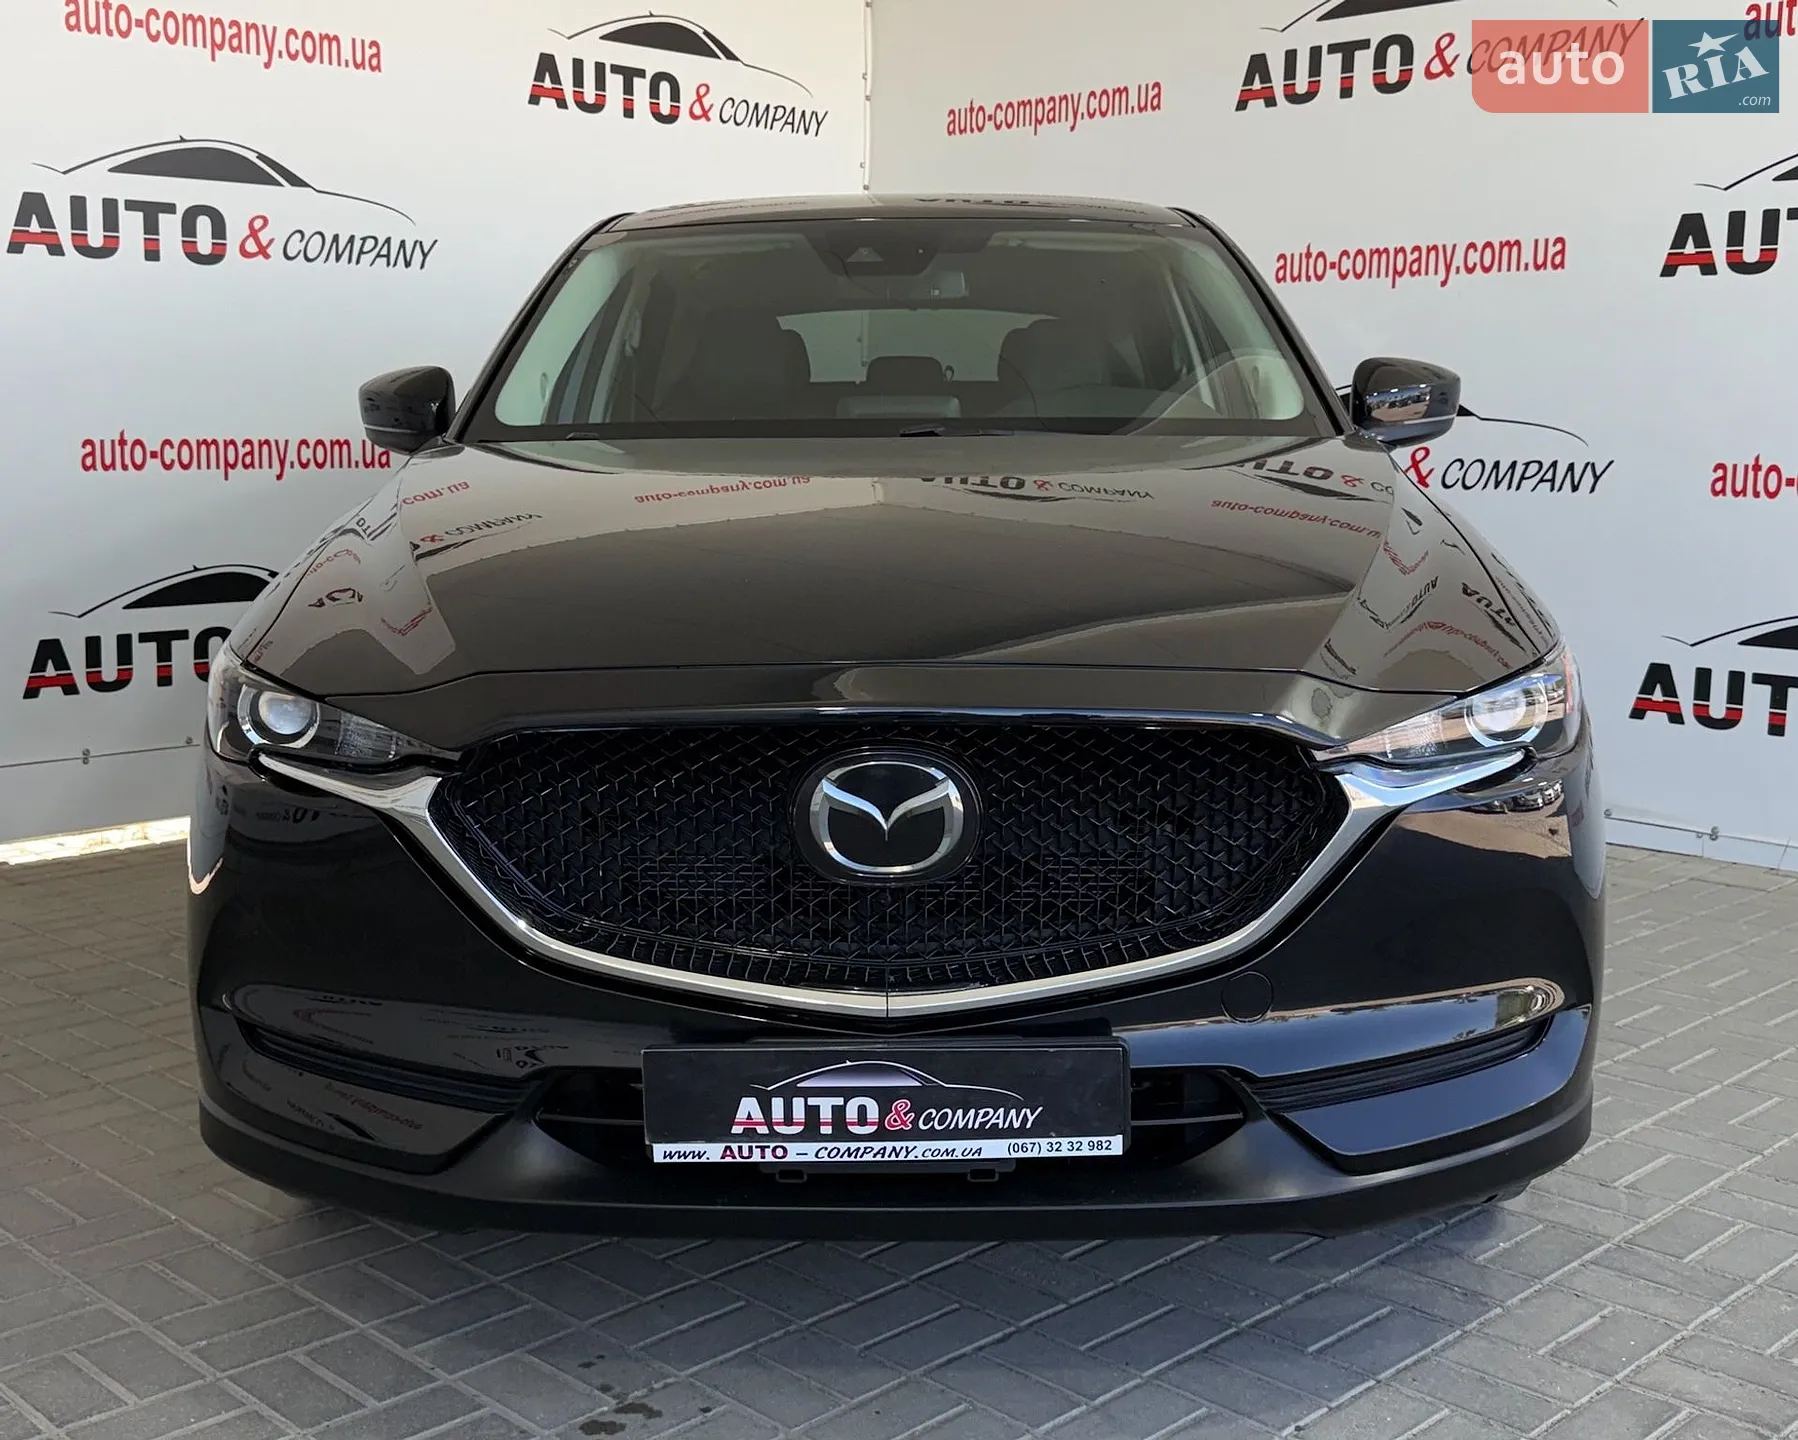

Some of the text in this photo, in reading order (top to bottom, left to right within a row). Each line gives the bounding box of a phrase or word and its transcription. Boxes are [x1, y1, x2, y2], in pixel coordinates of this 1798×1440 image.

[65, 0, 382, 72] auto-company.com.ua
[1235, 17, 1645, 112] AUTO & COMPANY
[528, 52, 829, 137] AUTO & COMPANY
[946, 80, 1163, 136] auto-company.com.ua
[6, 191, 438, 270] AUTO & COMPANY
[1275, 234, 1567, 289] auto-company.com.ua
[81, 428, 392, 481] auto-company.com.ua
[1405, 446, 1614, 494] & COMPANY
[1710, 452, 1798, 500] auto-
[1629, 662, 1798, 737] AUT
[730, 1096, 1044, 1135] AUTO & COMPANY
[720, 1145, 788, 1160] AUTO
[1007, 1141, 1042, 1156] (067)
[1046, 1141, 1062, 1153] 32
[1067, 1140, 1083, 1152] 32
[1087, 1139, 1112, 1151] 982
